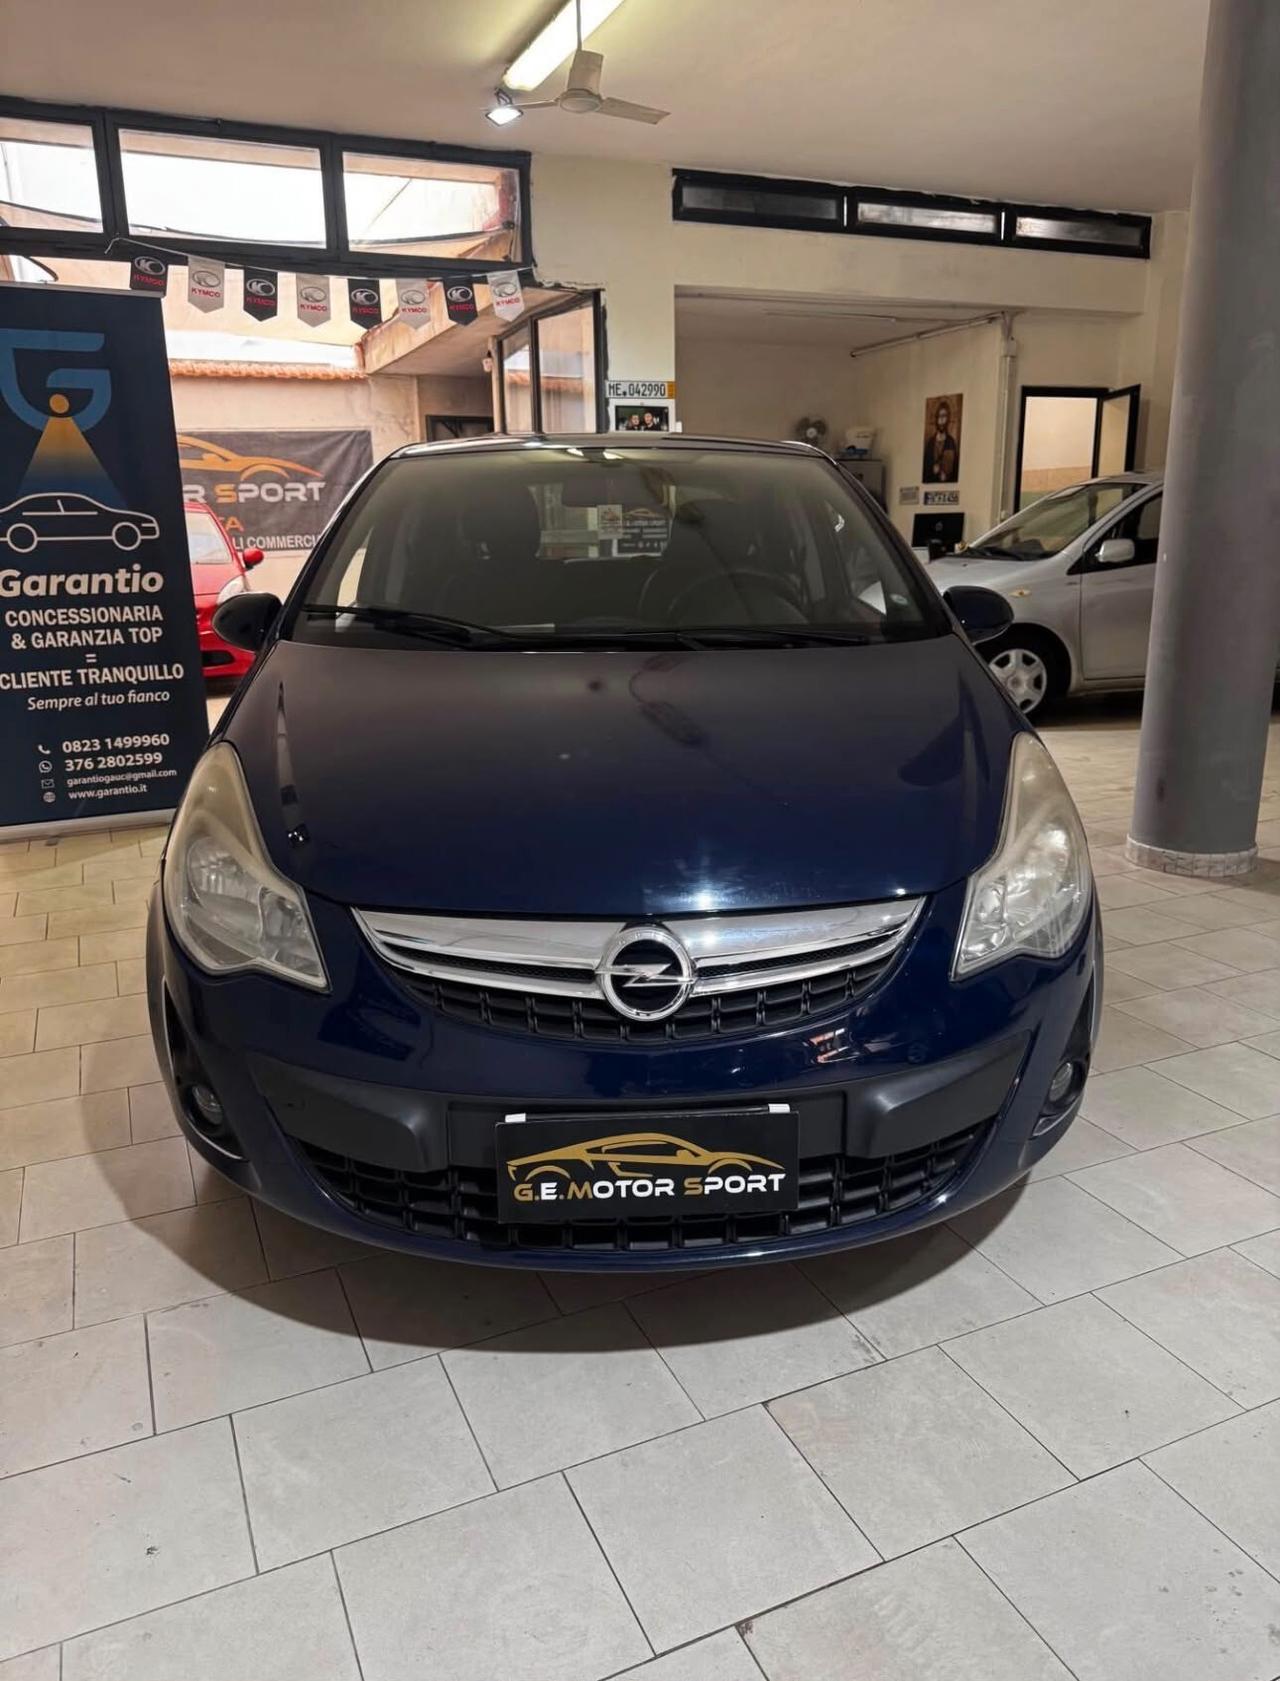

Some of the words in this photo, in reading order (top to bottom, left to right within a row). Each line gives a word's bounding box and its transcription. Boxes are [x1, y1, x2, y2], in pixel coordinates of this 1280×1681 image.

[191, 288, 221, 298] KYMCO
[495, 297, 520, 307] KYMCO
[300, 303, 327, 313] KYMCO
[214, 481, 325, 504] SPORT
[0, 563, 164, 597] Garantio
[5, 605, 163, 627] CONCESSIONARIA
[11, 633, 26, 650] &
[31, 630, 125, 648] GARANZIA
[129, 627, 163, 644] TOP
[0, 669, 73, 689] CLIENTE
[77, 663, 184, 686] TRANQUILLO
[27, 696, 81, 711] Sempre
[84, 693, 98, 706] al
[101, 692, 125, 705] tuo
[127, 689, 170, 703] fianco
[62, 739, 101, 753] 0823
[105, 733, 170, 750] 1499960
[65, 758, 94, 772] 376
[97, 752, 163, 769] 2802599
[68, 783, 148, 799] www.garantio.it
[513, 1178, 675, 1201] G.E.MOTOR
[683, 1173, 786, 1195] SPORT
